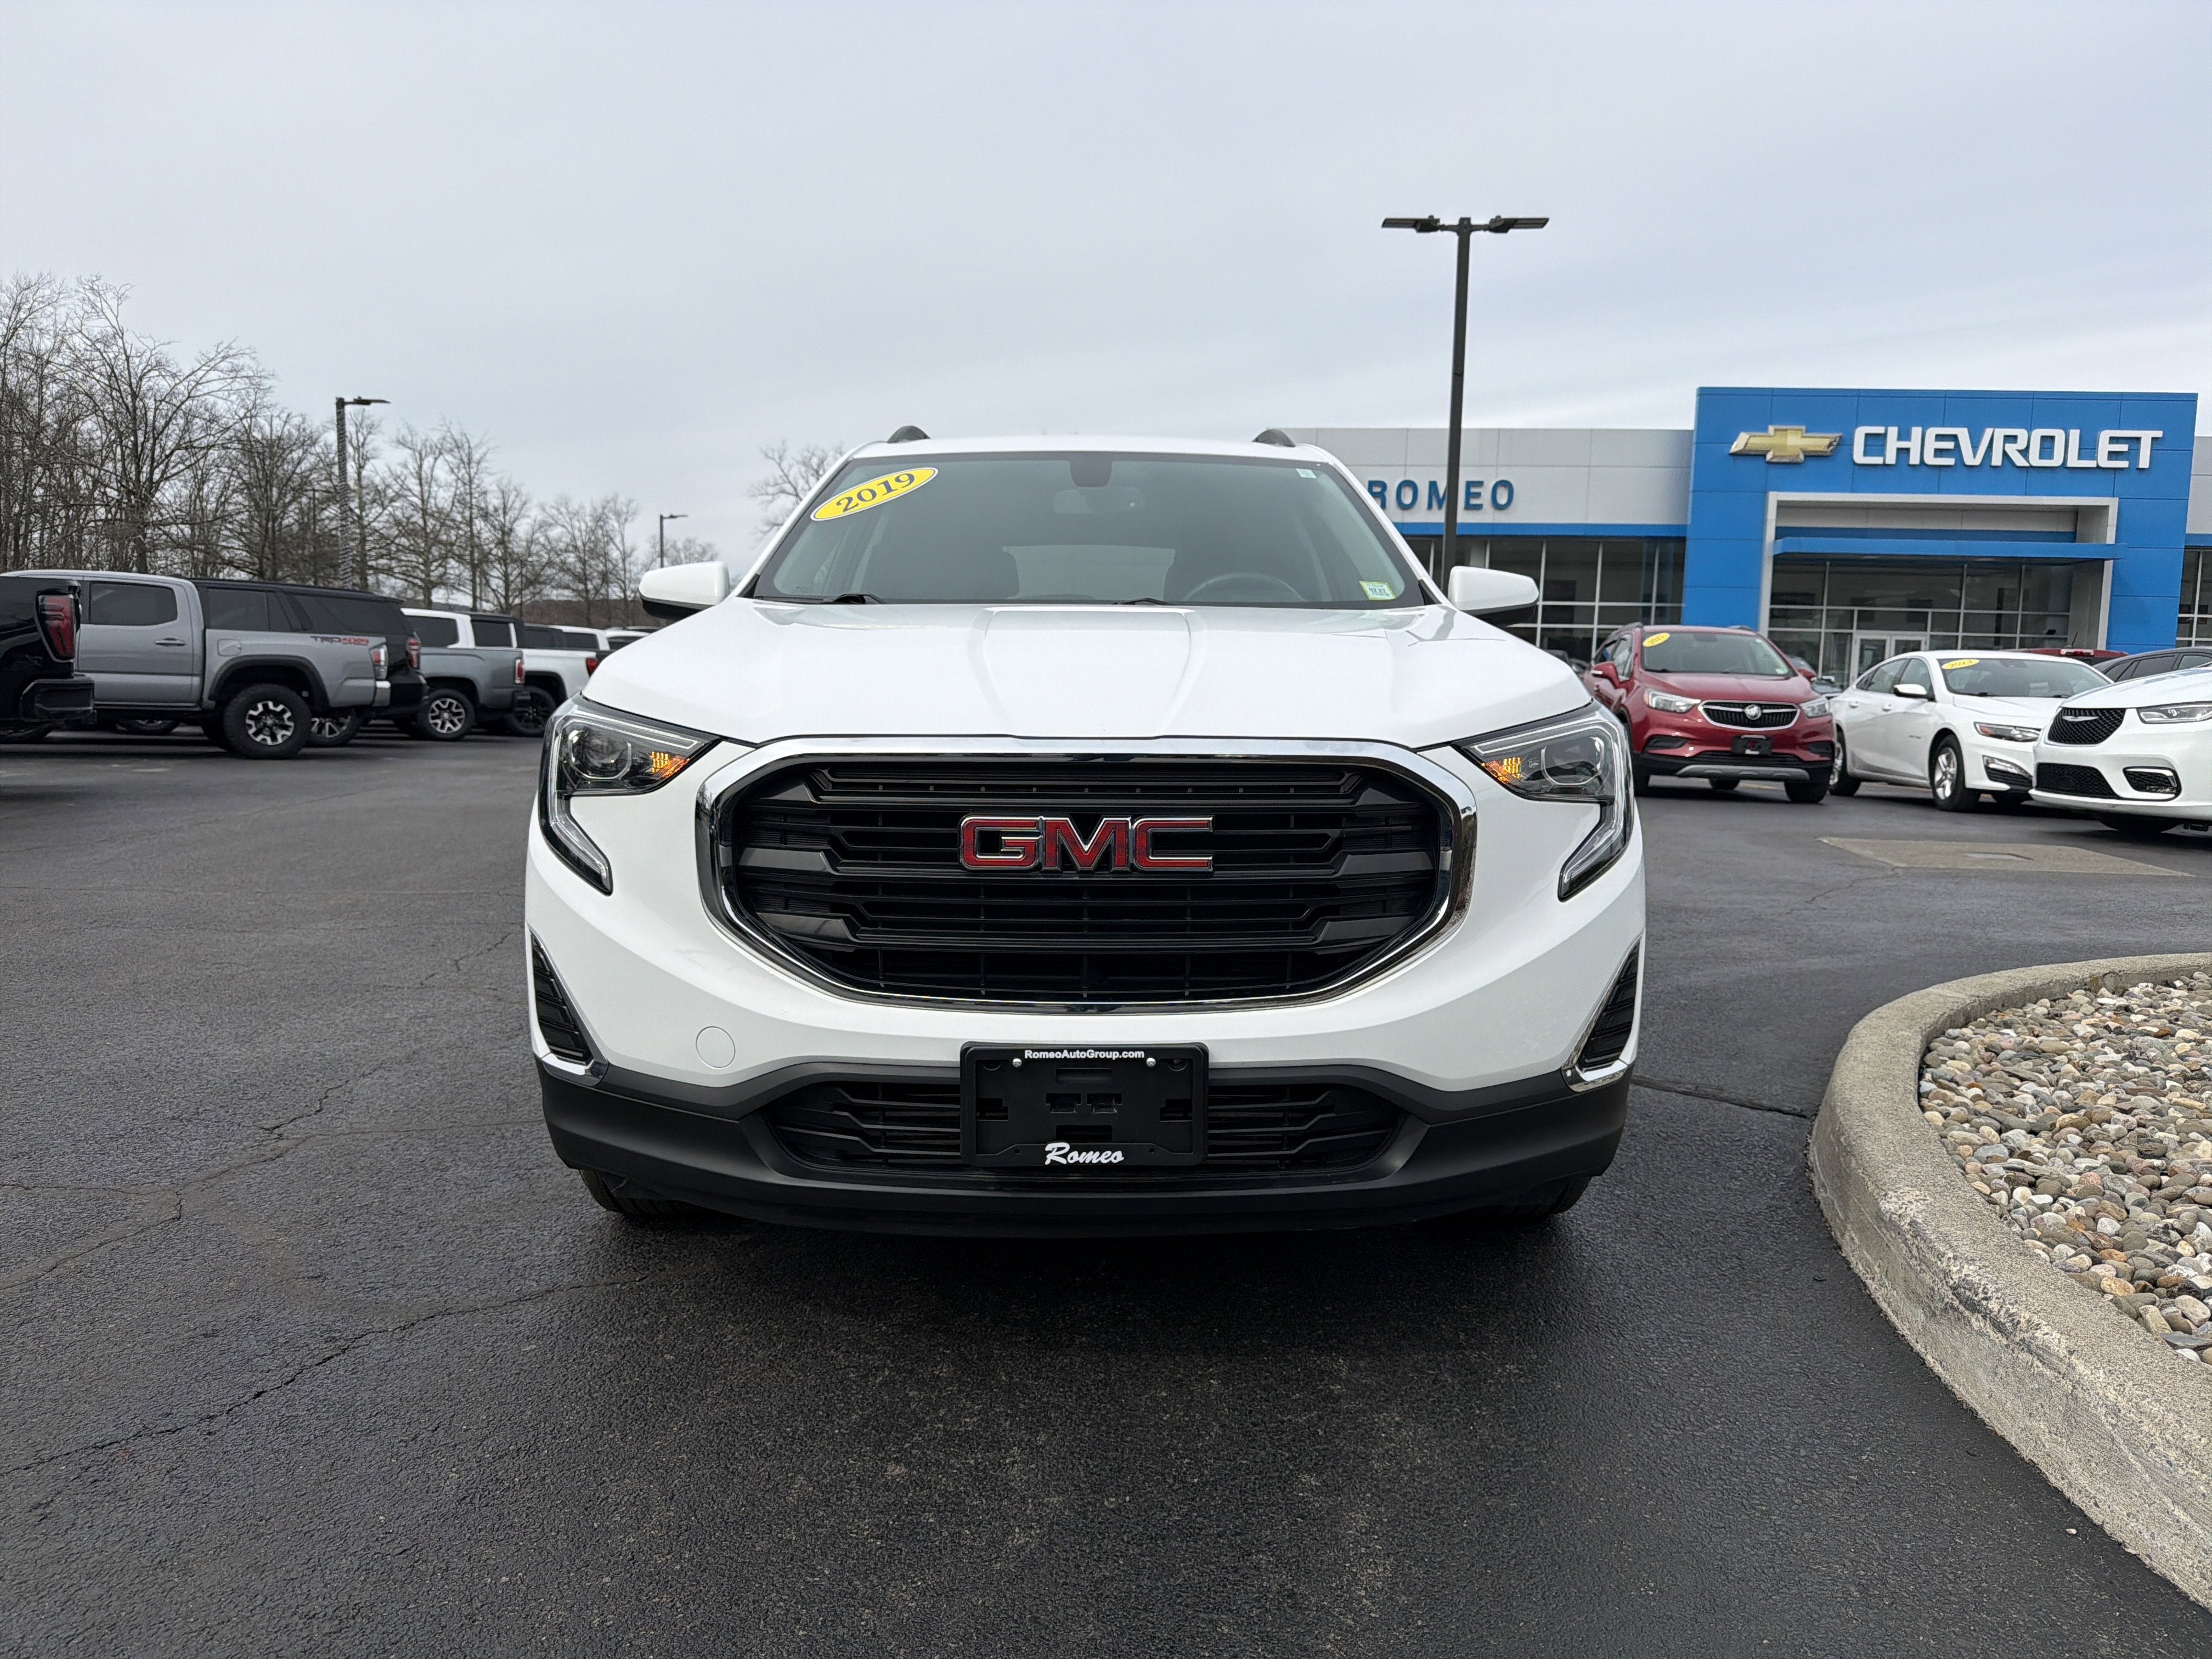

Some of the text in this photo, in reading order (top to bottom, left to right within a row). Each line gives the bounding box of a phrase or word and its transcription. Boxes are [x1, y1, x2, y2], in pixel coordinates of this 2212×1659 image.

[1853, 426, 2163, 469] CHEVROLET
[836, 473, 915, 513] 2019
[1368, 479, 1514, 510] ROMEO
[960, 815, 1214, 872] GMC
[1024, 1049, 1145, 1060] RomeoAutoGroup.com
[1045, 1142, 1124, 1165] Romeo
